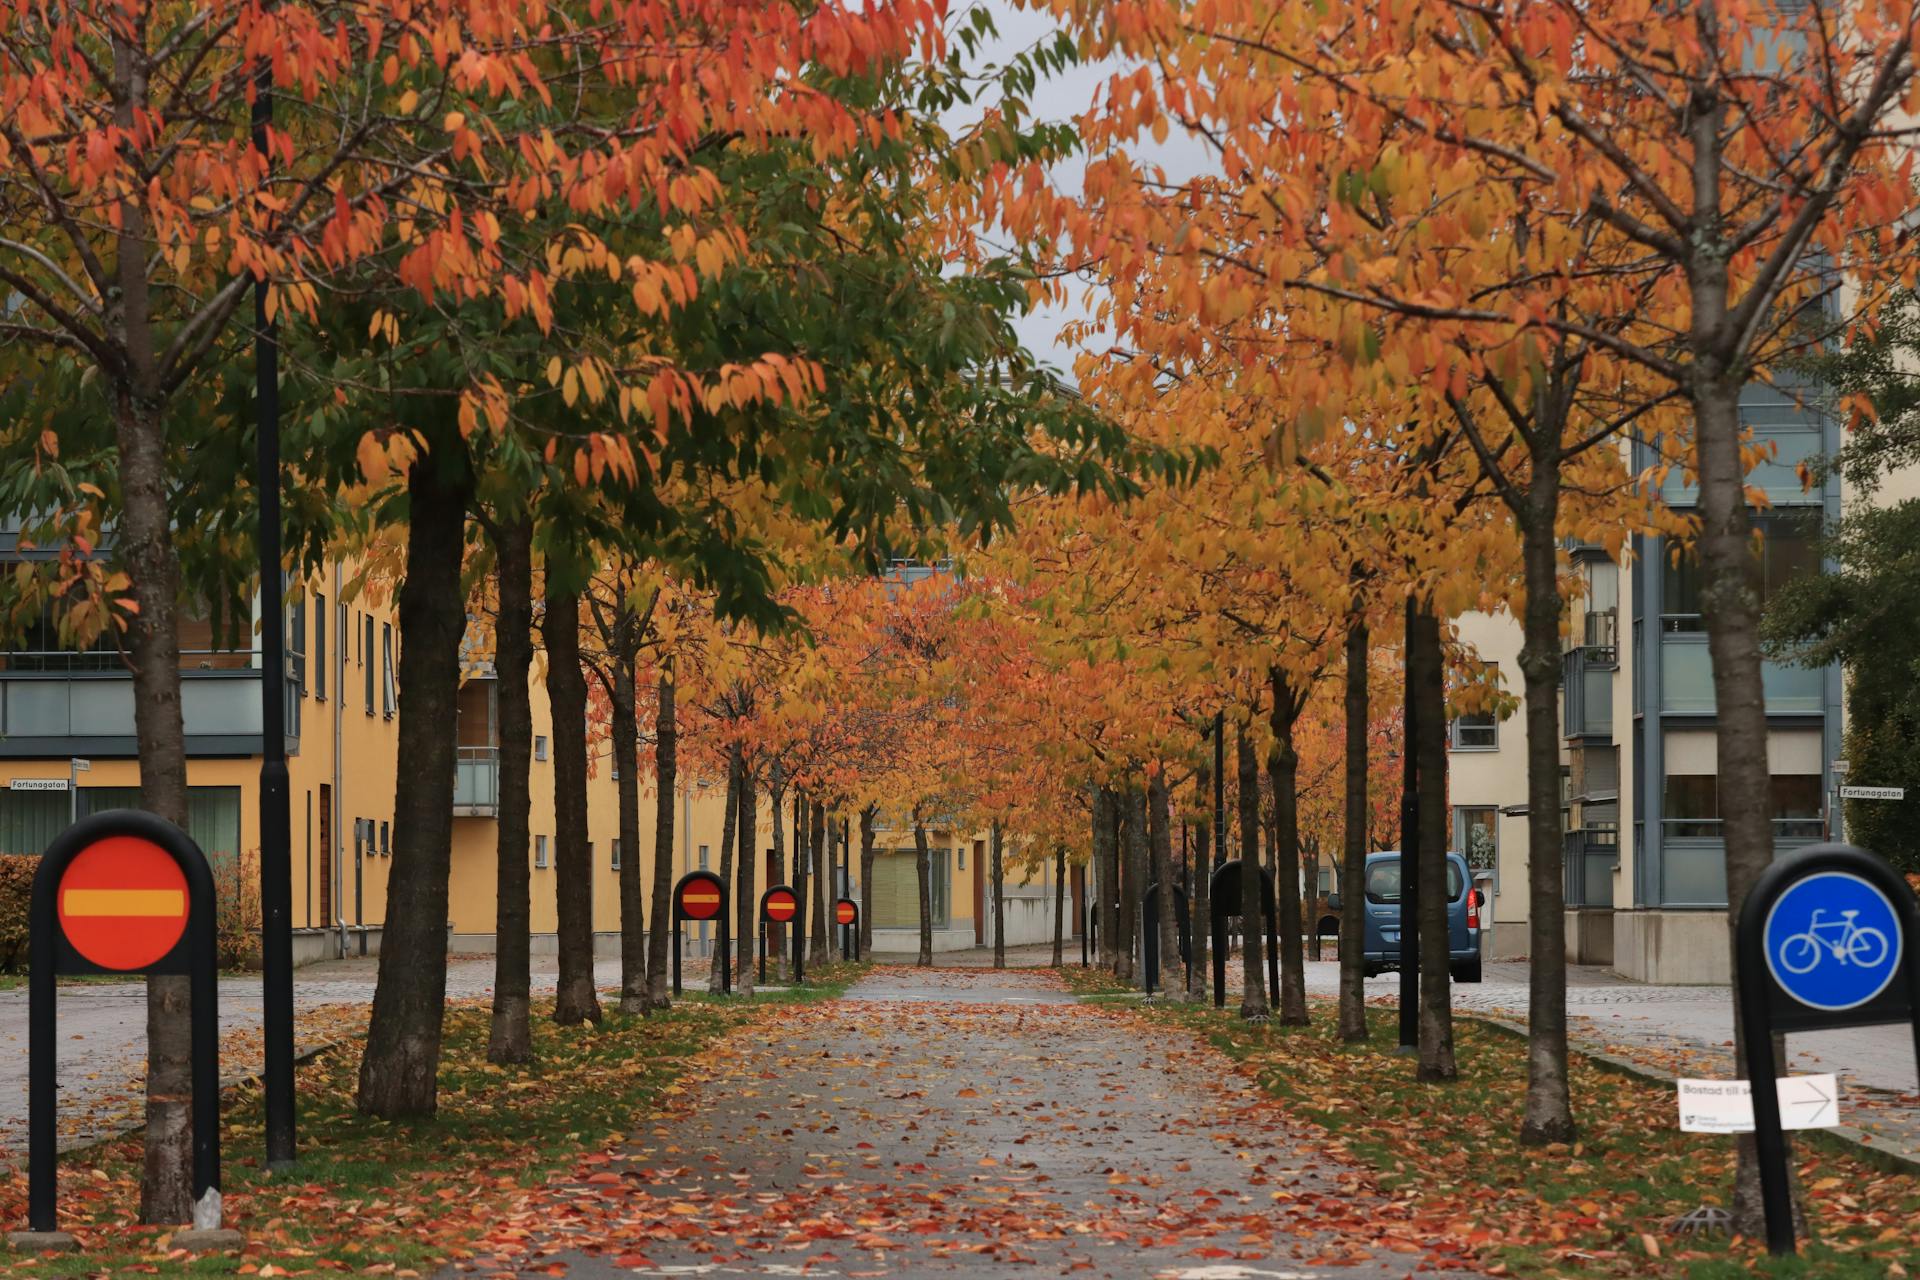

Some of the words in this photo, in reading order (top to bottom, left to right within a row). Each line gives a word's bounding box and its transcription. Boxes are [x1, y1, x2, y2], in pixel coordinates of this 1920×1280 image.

[13, 781, 66, 789] Fortunagatan
[1843, 788, 1902, 798] Fortunagatan
[1683, 1085, 1722, 1095] Bostad
[1726, 1086, 1738, 1096] till
